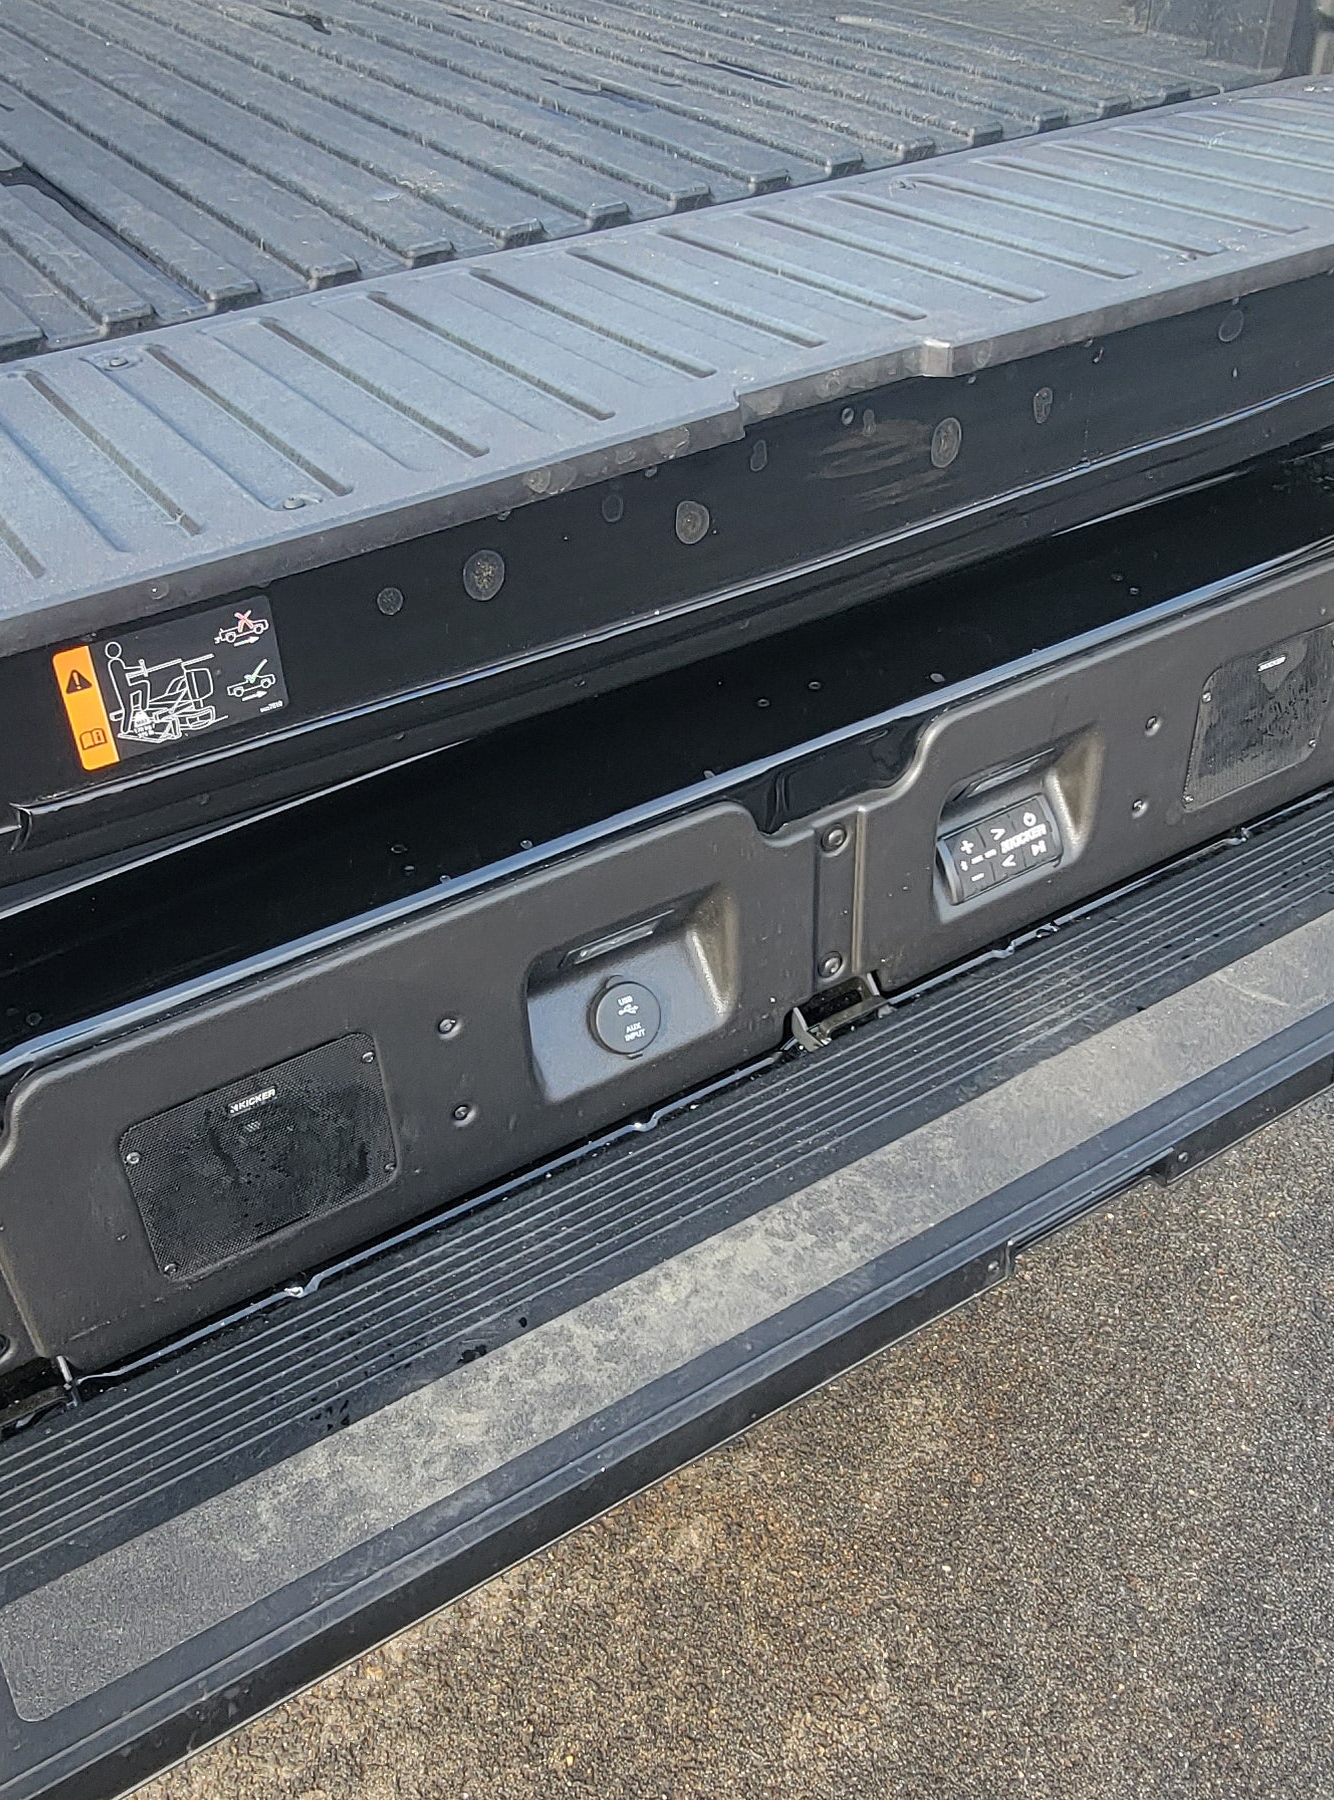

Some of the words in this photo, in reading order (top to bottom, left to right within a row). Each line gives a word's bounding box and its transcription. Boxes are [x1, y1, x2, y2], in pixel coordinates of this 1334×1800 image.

[626, 1021, 642, 1034] AUX
[624, 1028, 646, 1042] INPUT
[238, 1088, 276, 1110] KICKER
